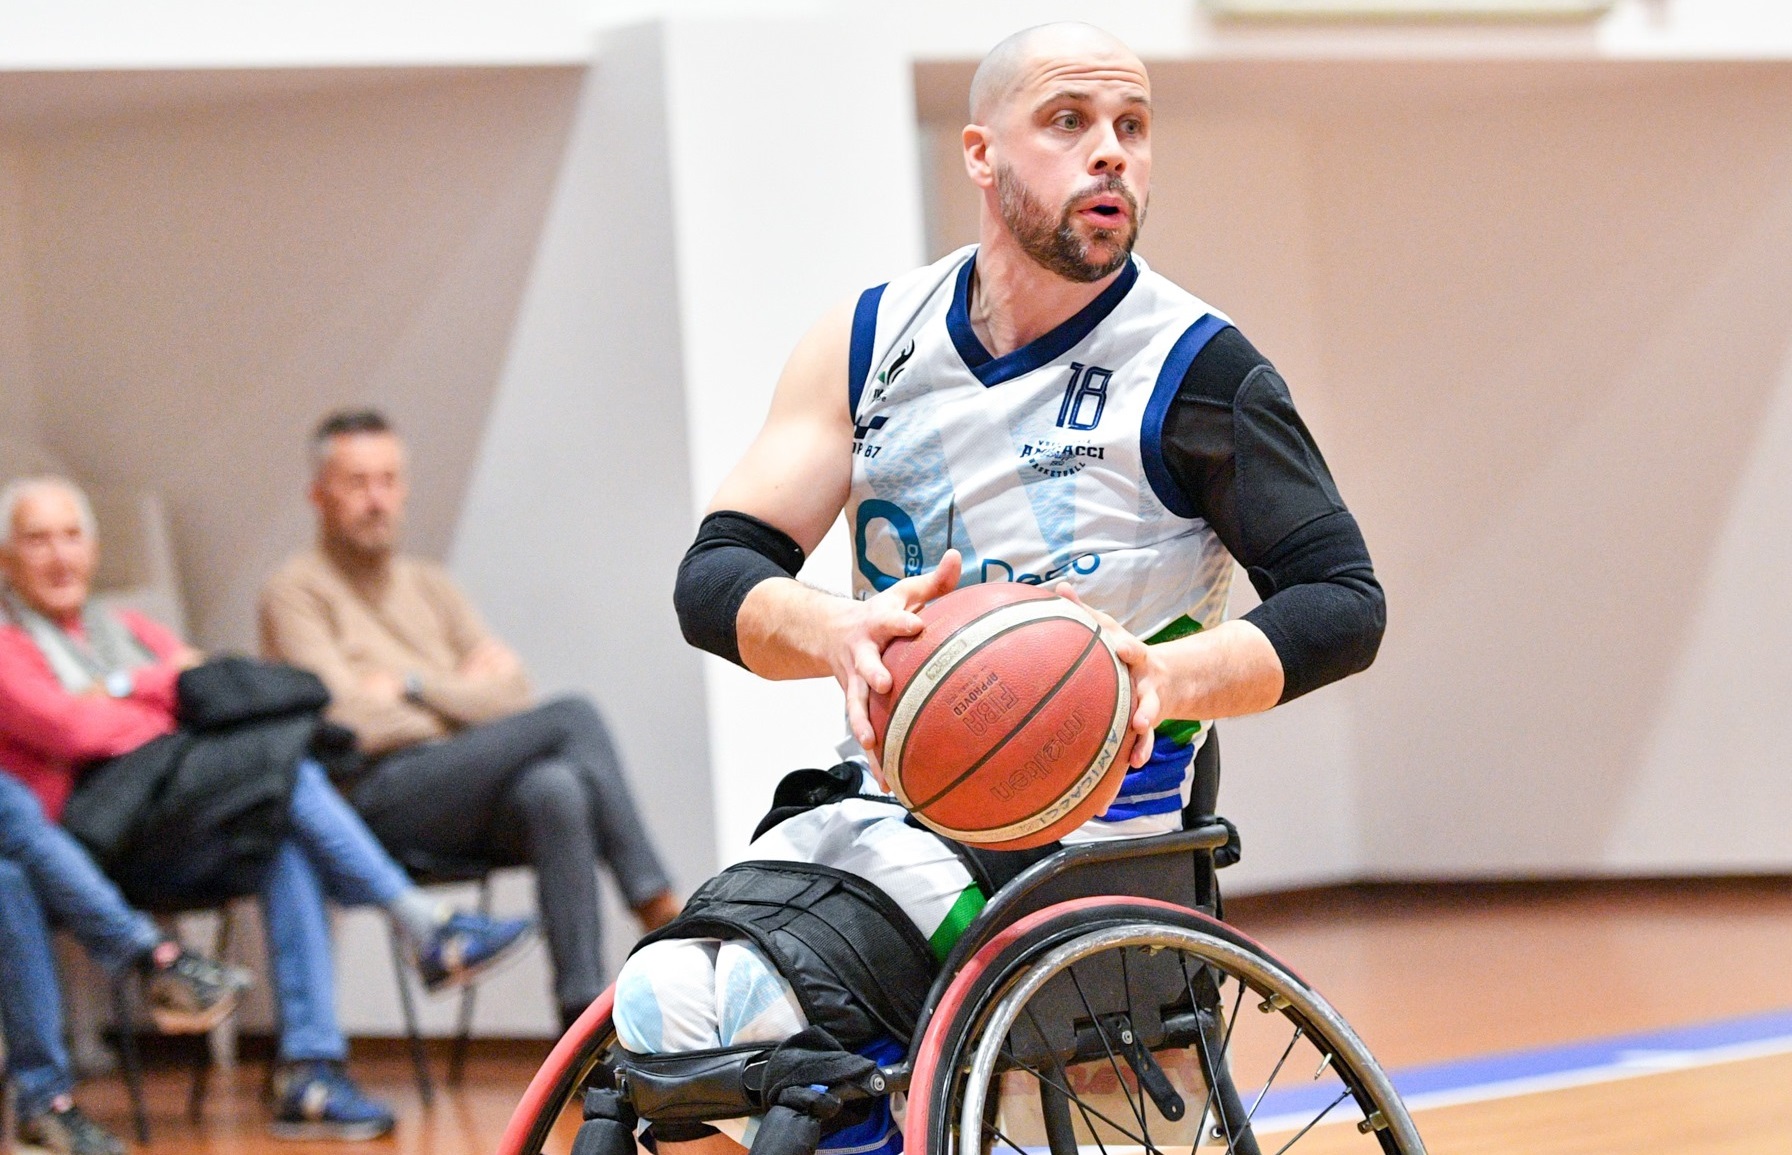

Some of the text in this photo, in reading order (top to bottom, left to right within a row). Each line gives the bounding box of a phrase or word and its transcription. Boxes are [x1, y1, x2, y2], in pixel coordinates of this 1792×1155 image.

[1056, 361, 1114, 431] 18
[864, 445, 882, 459] 87
[953, 671, 999, 717] APPROVED
[962, 682, 1019, 737] FIBA
[990, 709, 1087, 802] molten
[1039, 728, 1118, 825] AMICACCI
